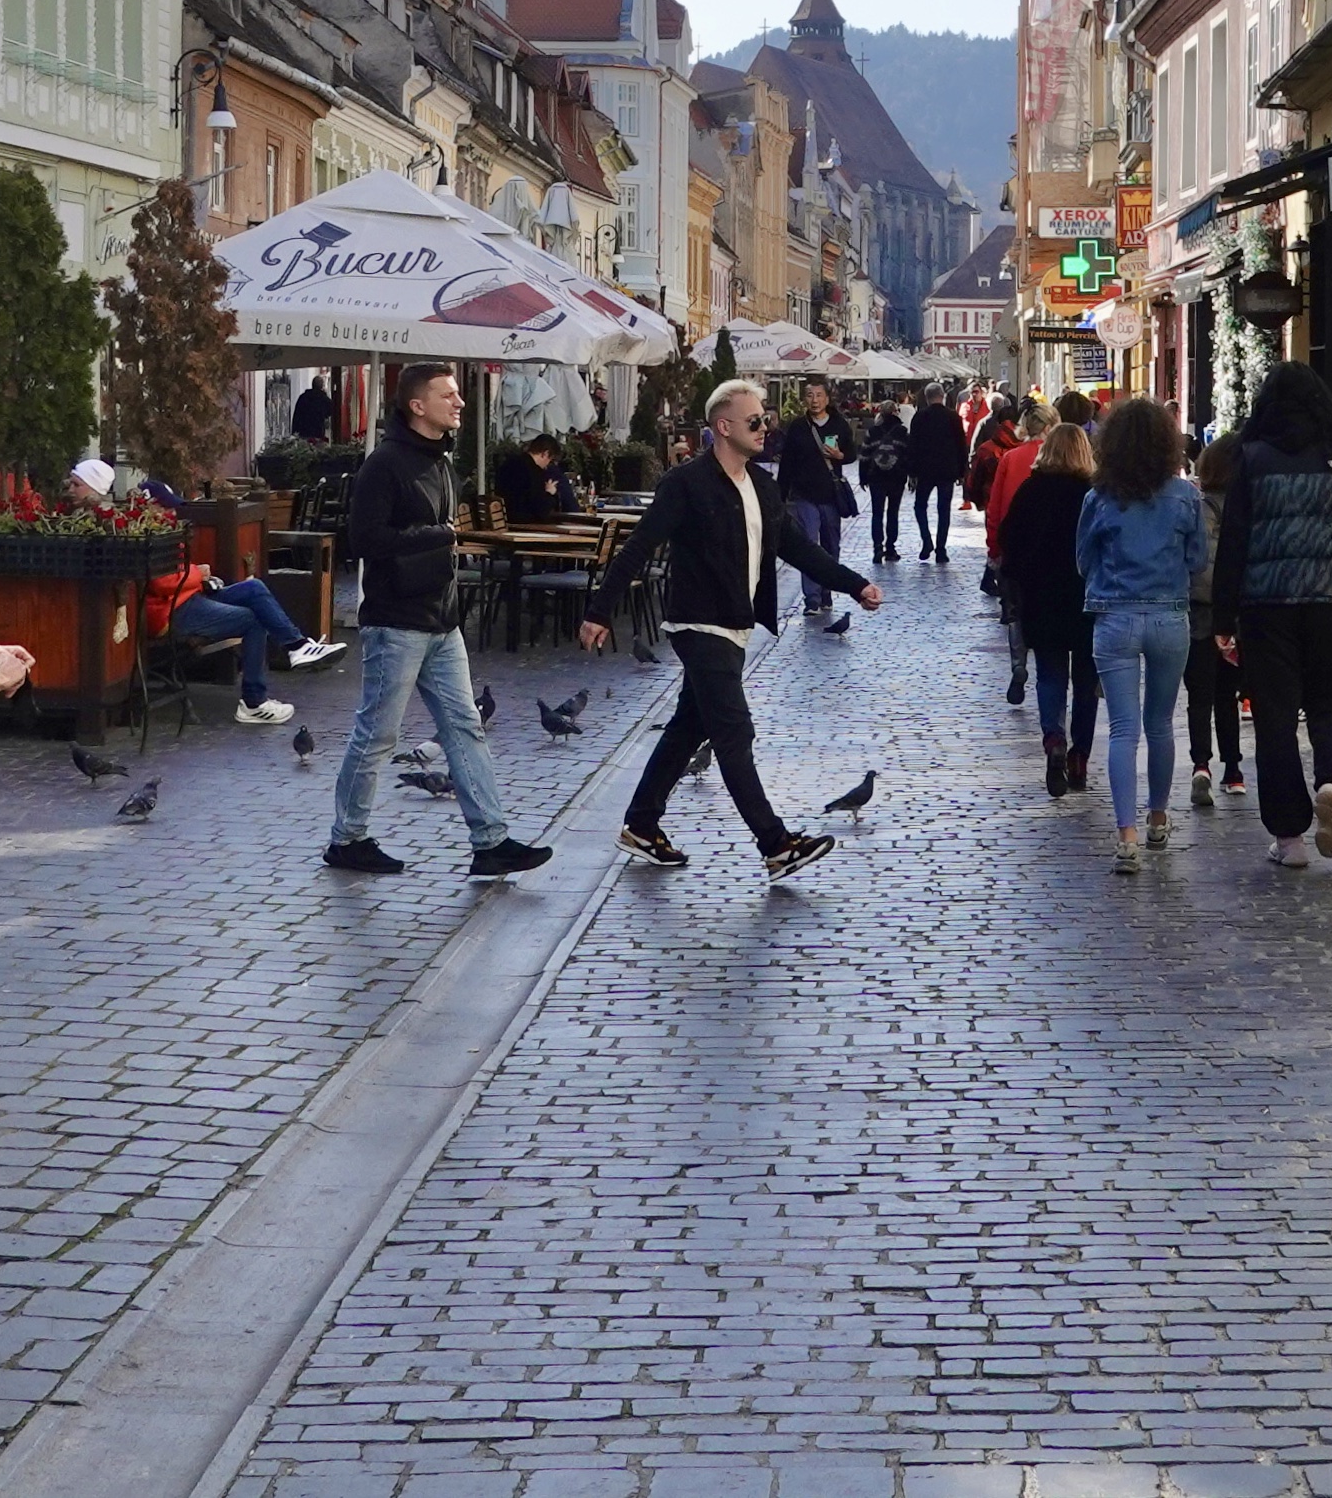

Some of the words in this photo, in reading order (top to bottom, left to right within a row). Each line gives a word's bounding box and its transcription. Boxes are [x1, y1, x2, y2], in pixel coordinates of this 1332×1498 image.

[1053, 209, 1109, 221] XEROX
[1049, 221, 1112, 229] REUMPLEM
[261, 236, 444, 291] Bucur
[301, 295, 318, 304] de
[327, 296, 400, 310] bulevard
[1117, 313, 1137, 323] First
[255, 318, 292, 336] bere
[303, 320, 321, 338] de
[331, 322, 410, 344] bulevard
[1030, 330, 1057, 338] Tattoo
[1117, 323, 1135, 334] Cup
[501, 335, 538, 354] Bucur
